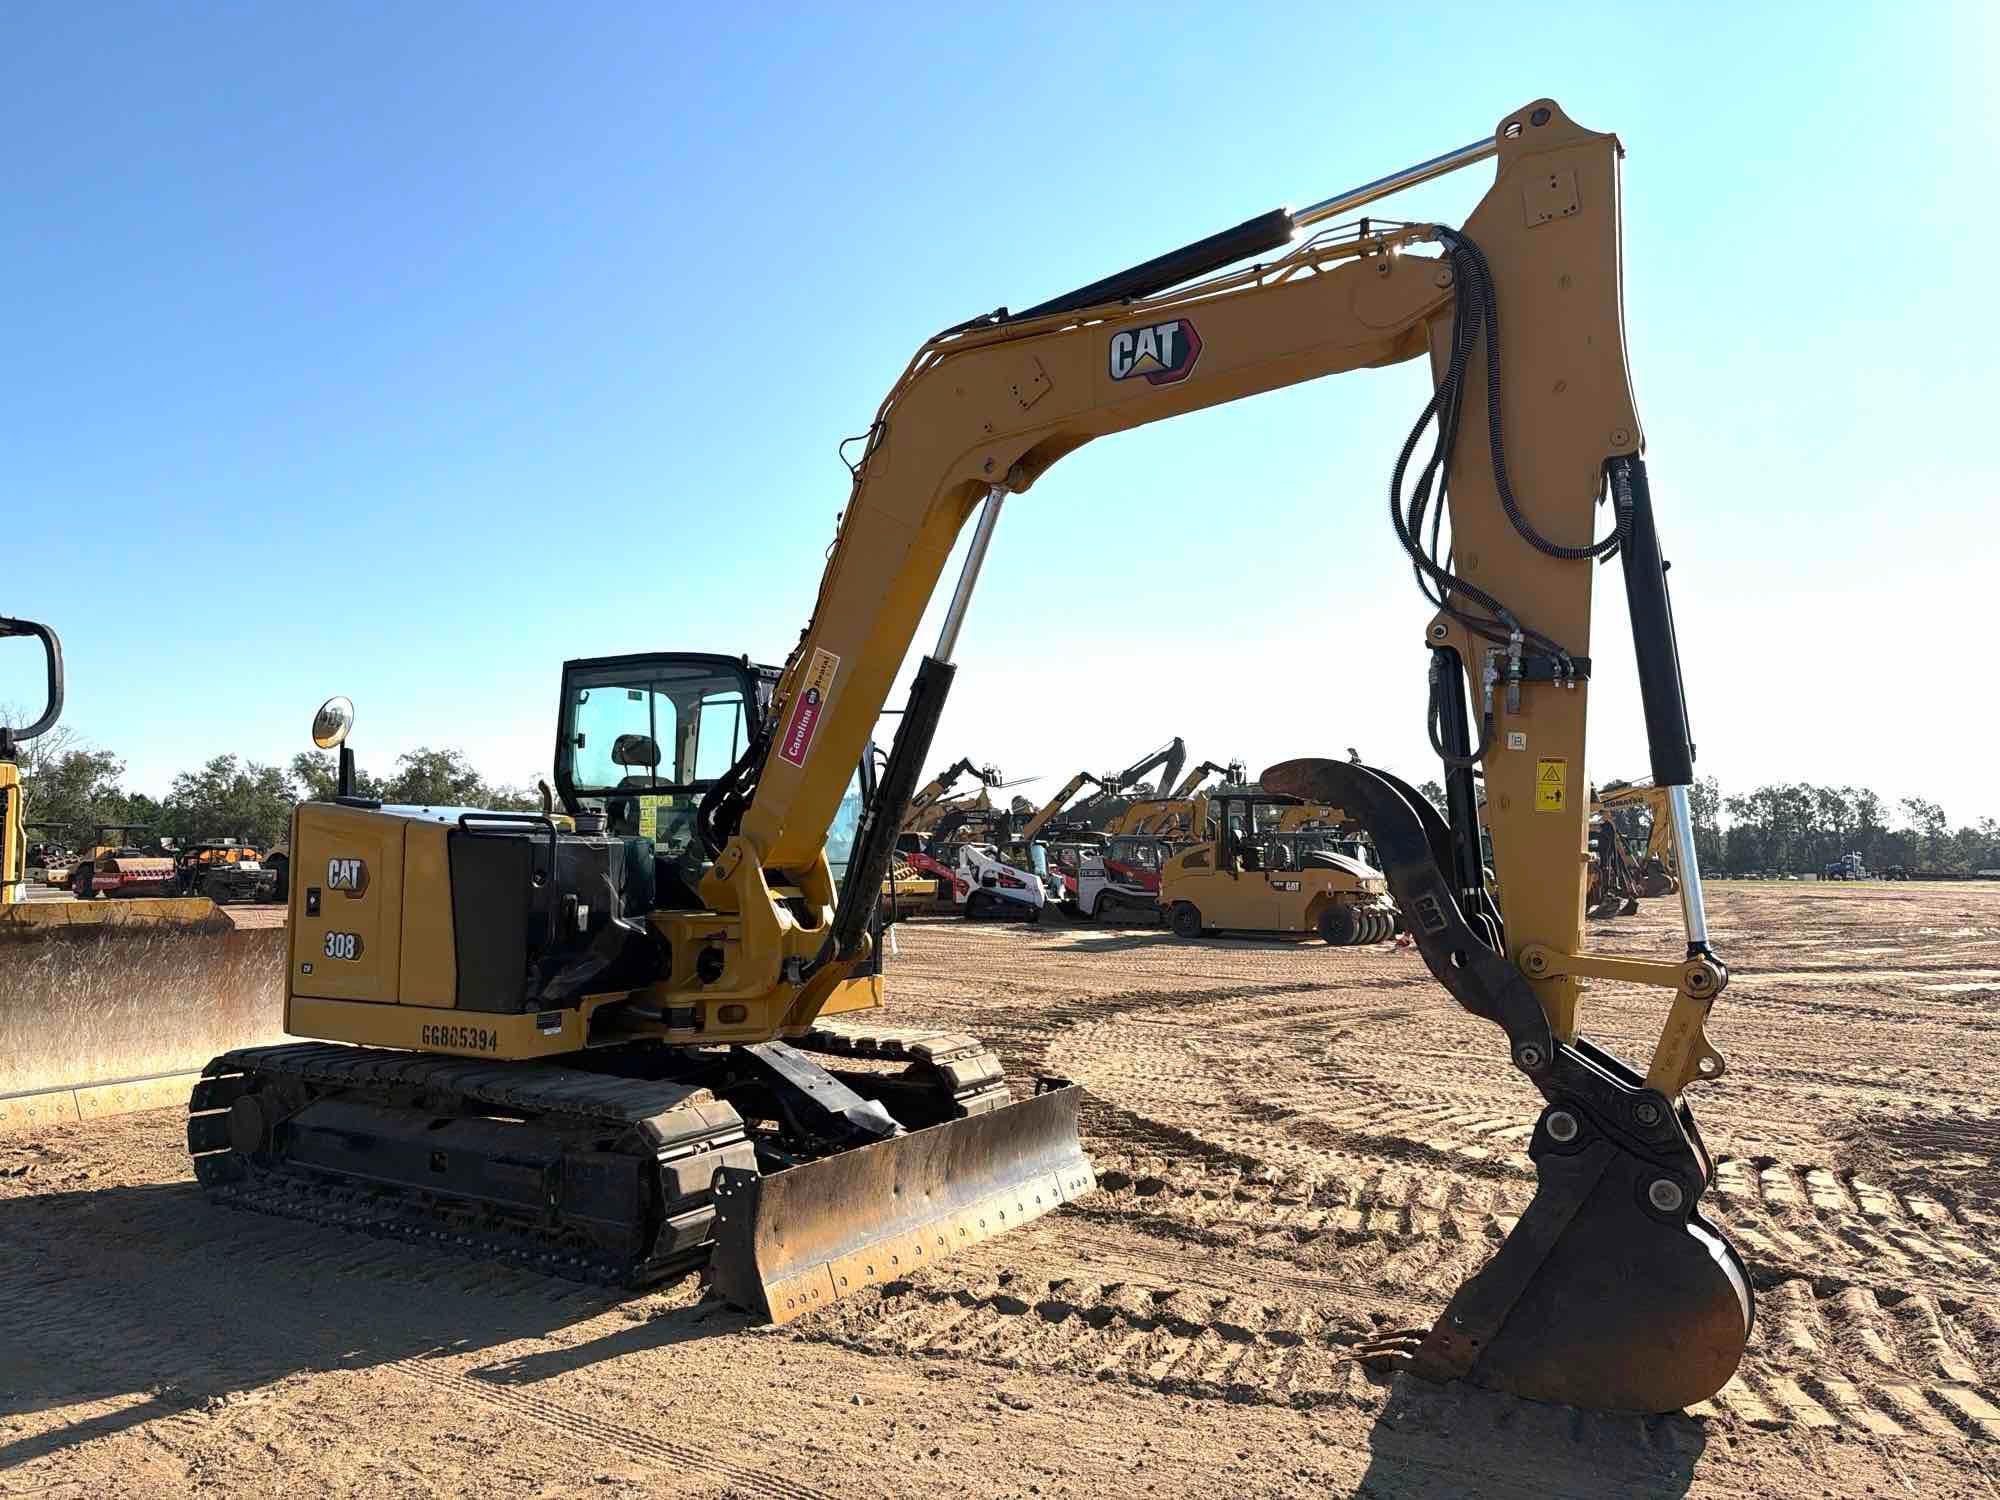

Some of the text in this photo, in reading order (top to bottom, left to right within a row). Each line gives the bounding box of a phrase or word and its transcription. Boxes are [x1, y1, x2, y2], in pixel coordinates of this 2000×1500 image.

[1110, 321, 1179, 379] CAT
[788, 709, 813, 757] Carolina
[814, 655, 830, 688] Rental
[1603, 797, 1644, 809] KOMATSU
[327, 859, 361, 890] CAT
[325, 932, 356, 960] 308
[422, 1024, 497, 1052] GG805394
